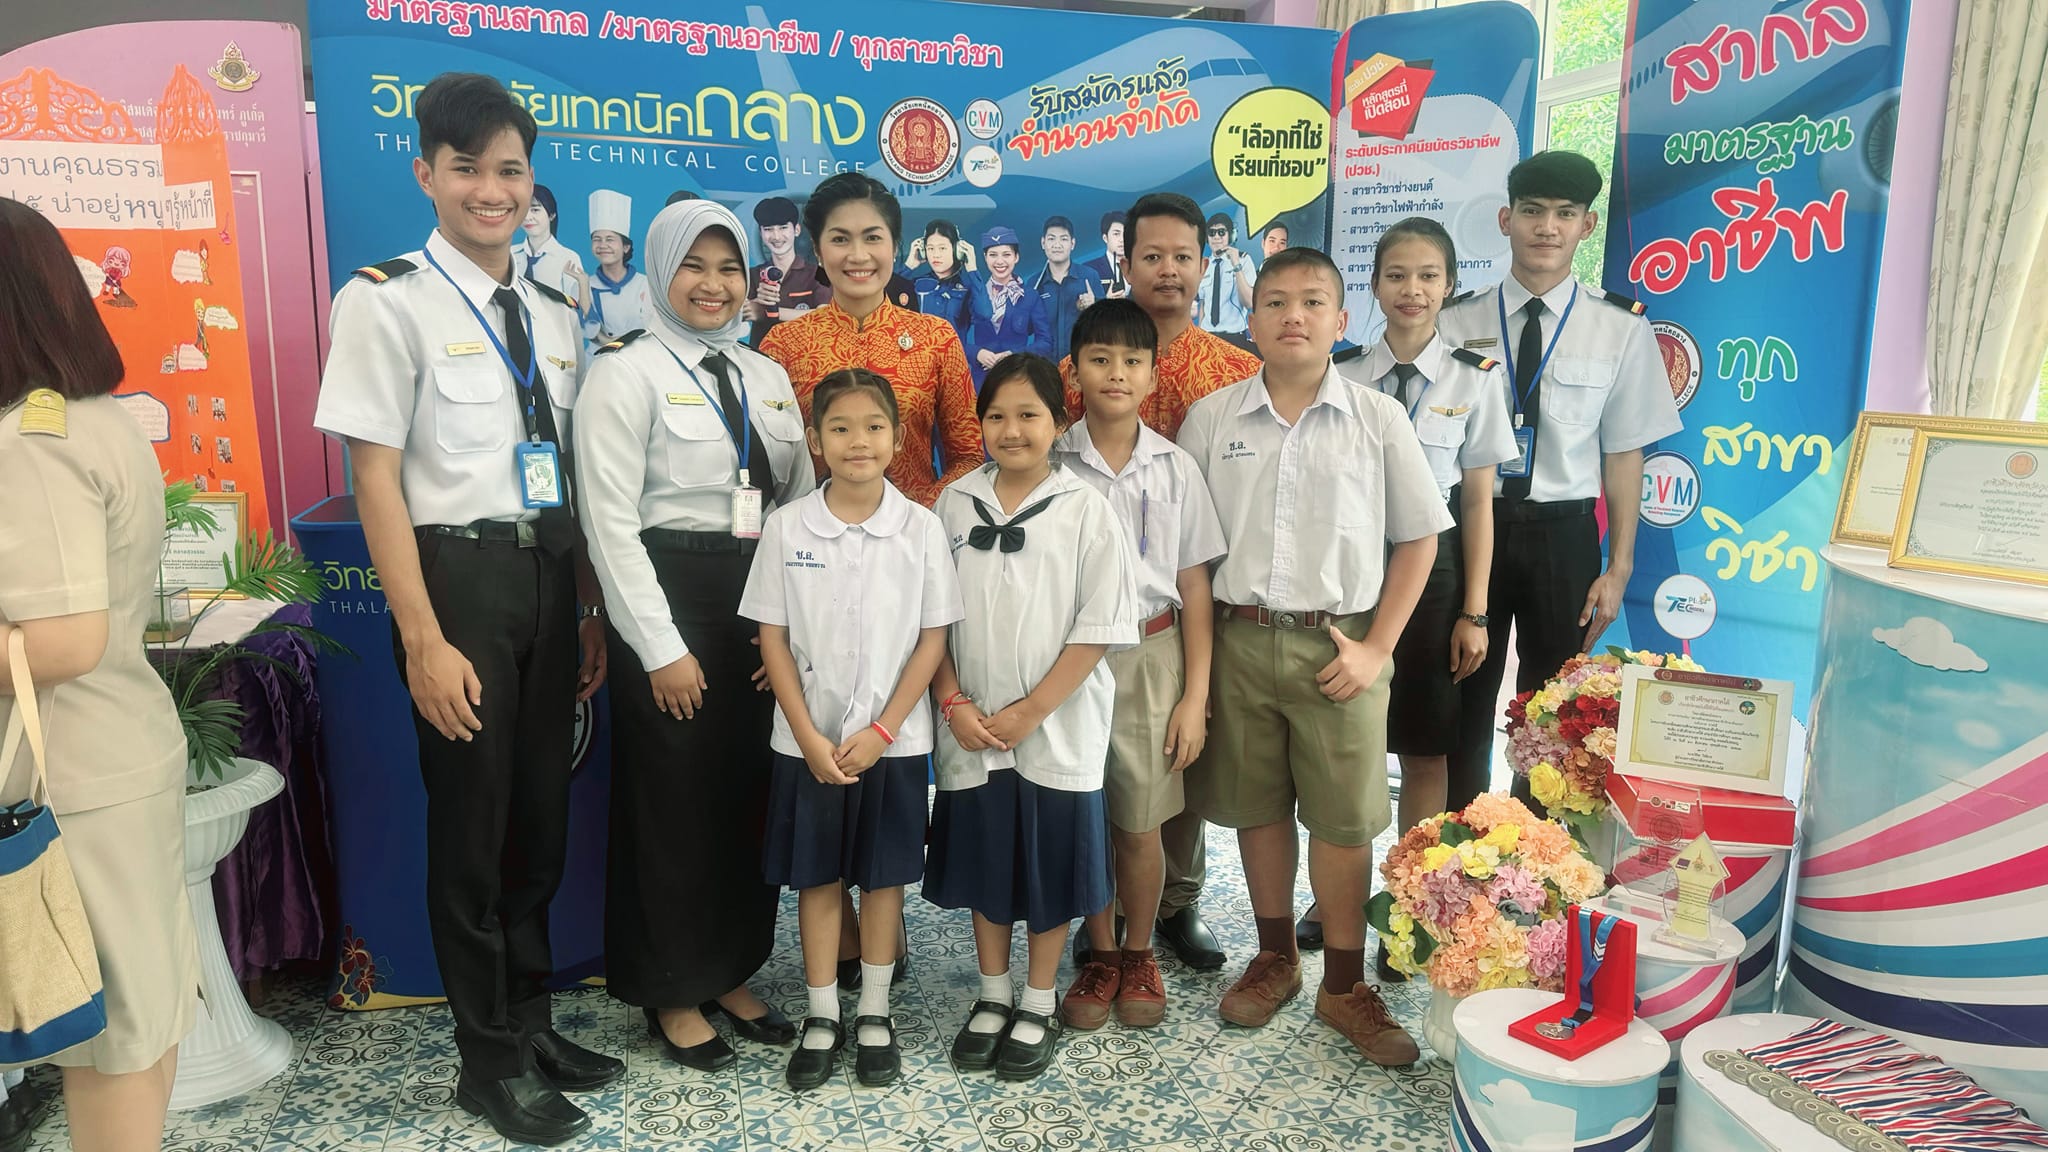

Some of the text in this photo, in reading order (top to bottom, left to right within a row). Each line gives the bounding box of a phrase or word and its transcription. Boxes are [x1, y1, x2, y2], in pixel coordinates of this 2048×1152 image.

[851, 33, 1003, 70] ทุกสาขาวิชา
[1665, 0, 1869, 104] สากล
[1029, 57, 1188, 119] รับสมัครแล้ว
[1362, 78, 1408, 107] หลักสูตรที่
[969, 110, 999, 128] CVM
[1007, 89, 1200, 161] จำนวนจำกัด
[1365, 95, 1411, 121] เปิดสอน
[550, 141, 865, 178] TECHNICAL COLLEGE
[1345, 135, 1501, 159] ระดับประกาศนียบัตรวิชาชีพ
[1664, 115, 1853, 174] มาตรฐาน
[1345, 163, 1380, 180] (ปวช.)
[1352, 178, 1434, 196] สาขาวิชาช่างยนต์
[1351, 199, 1444, 216] สาขาวิชาไฟฟ้ากำลัง
[1628, 178, 1849, 295] อาชีพ
[1717, 336, 1799, 402] ทุก
[1702, 422, 1833, 475] สาขา
[1701, 506, 1819, 592] วิชา
